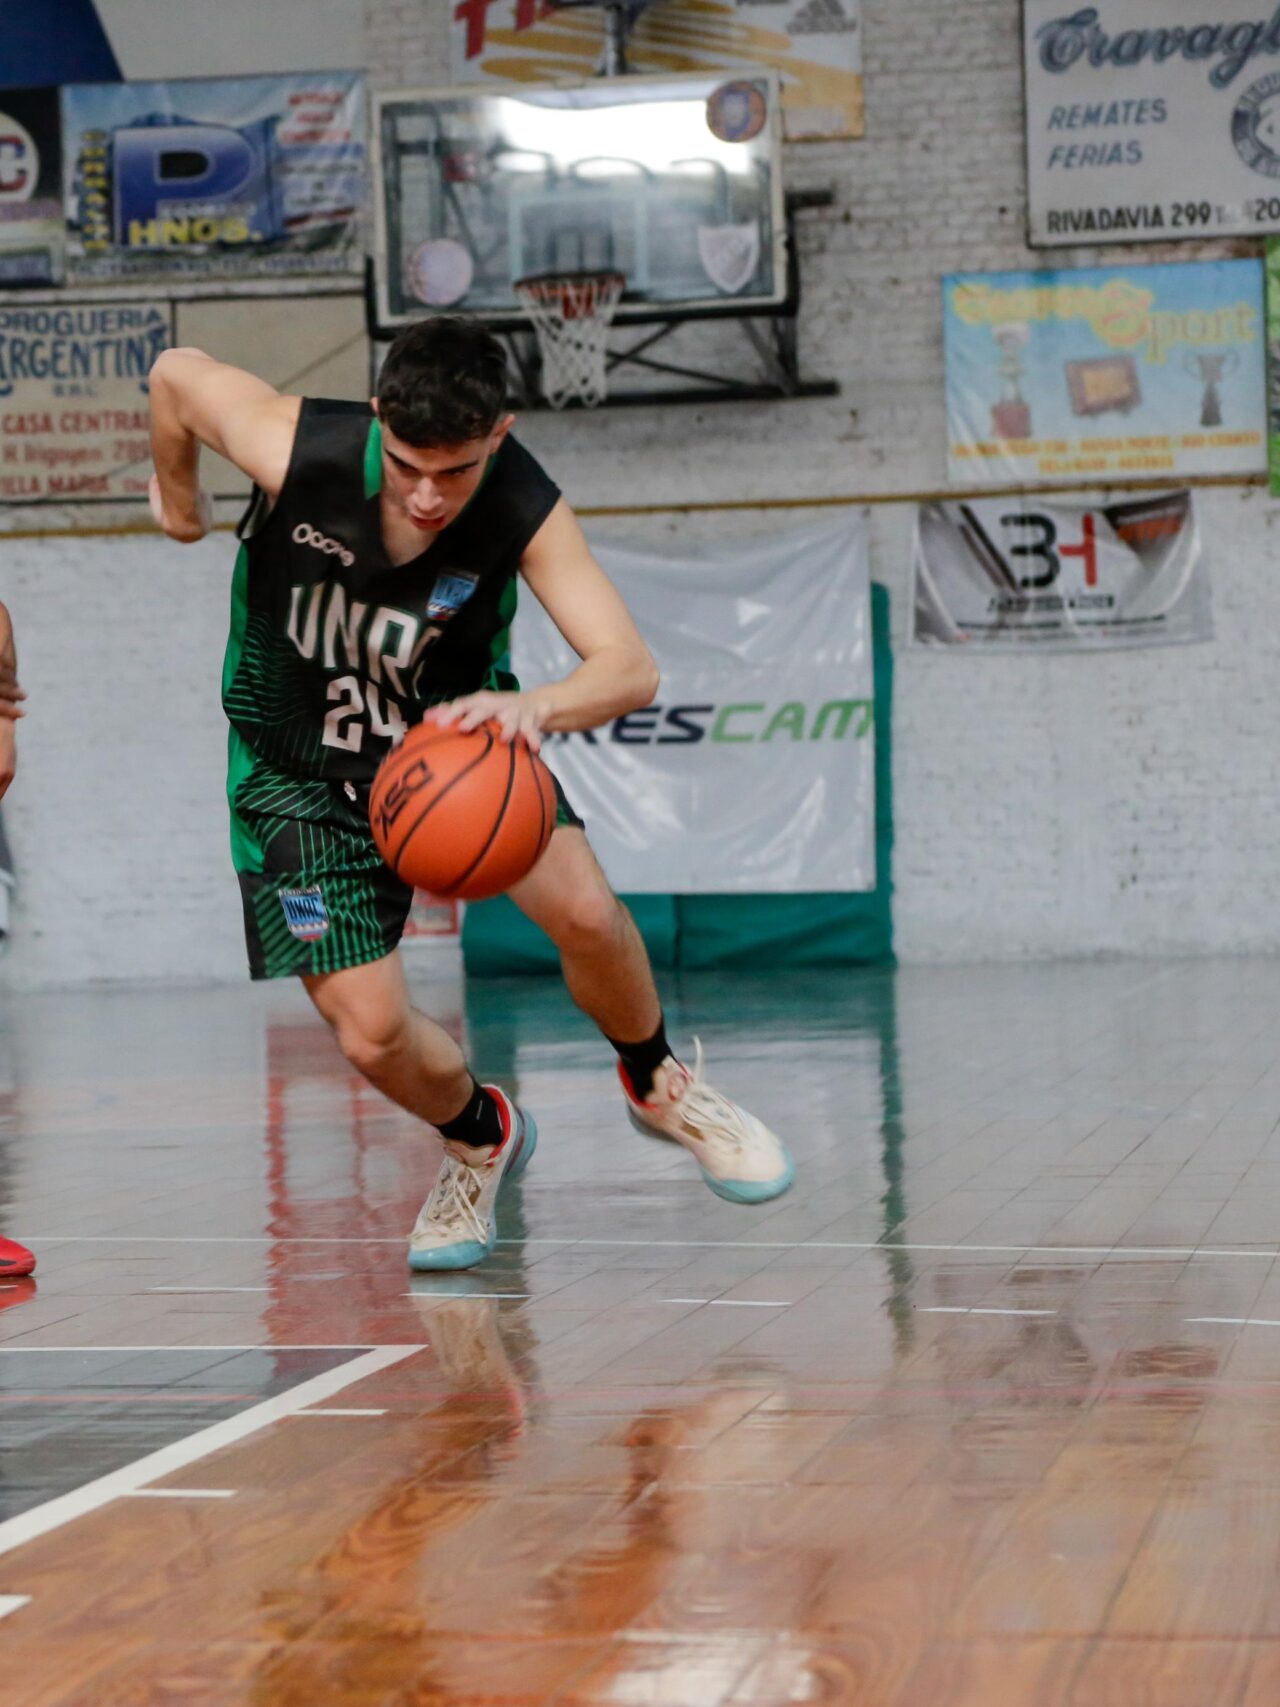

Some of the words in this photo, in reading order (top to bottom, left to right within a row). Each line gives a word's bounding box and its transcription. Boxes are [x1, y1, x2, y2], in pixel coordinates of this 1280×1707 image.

[1047, 98, 1168, 130] REMATES
[1047, 140, 1143, 169] FERIAS
[128, 216, 263, 246] HNOS.
[1047, 205, 1164, 233] RIVADAVIA
[1171, 202, 1211, 225] 299
[2, 412, 53, 435] CASA
[321, 674, 408, 753] 24
